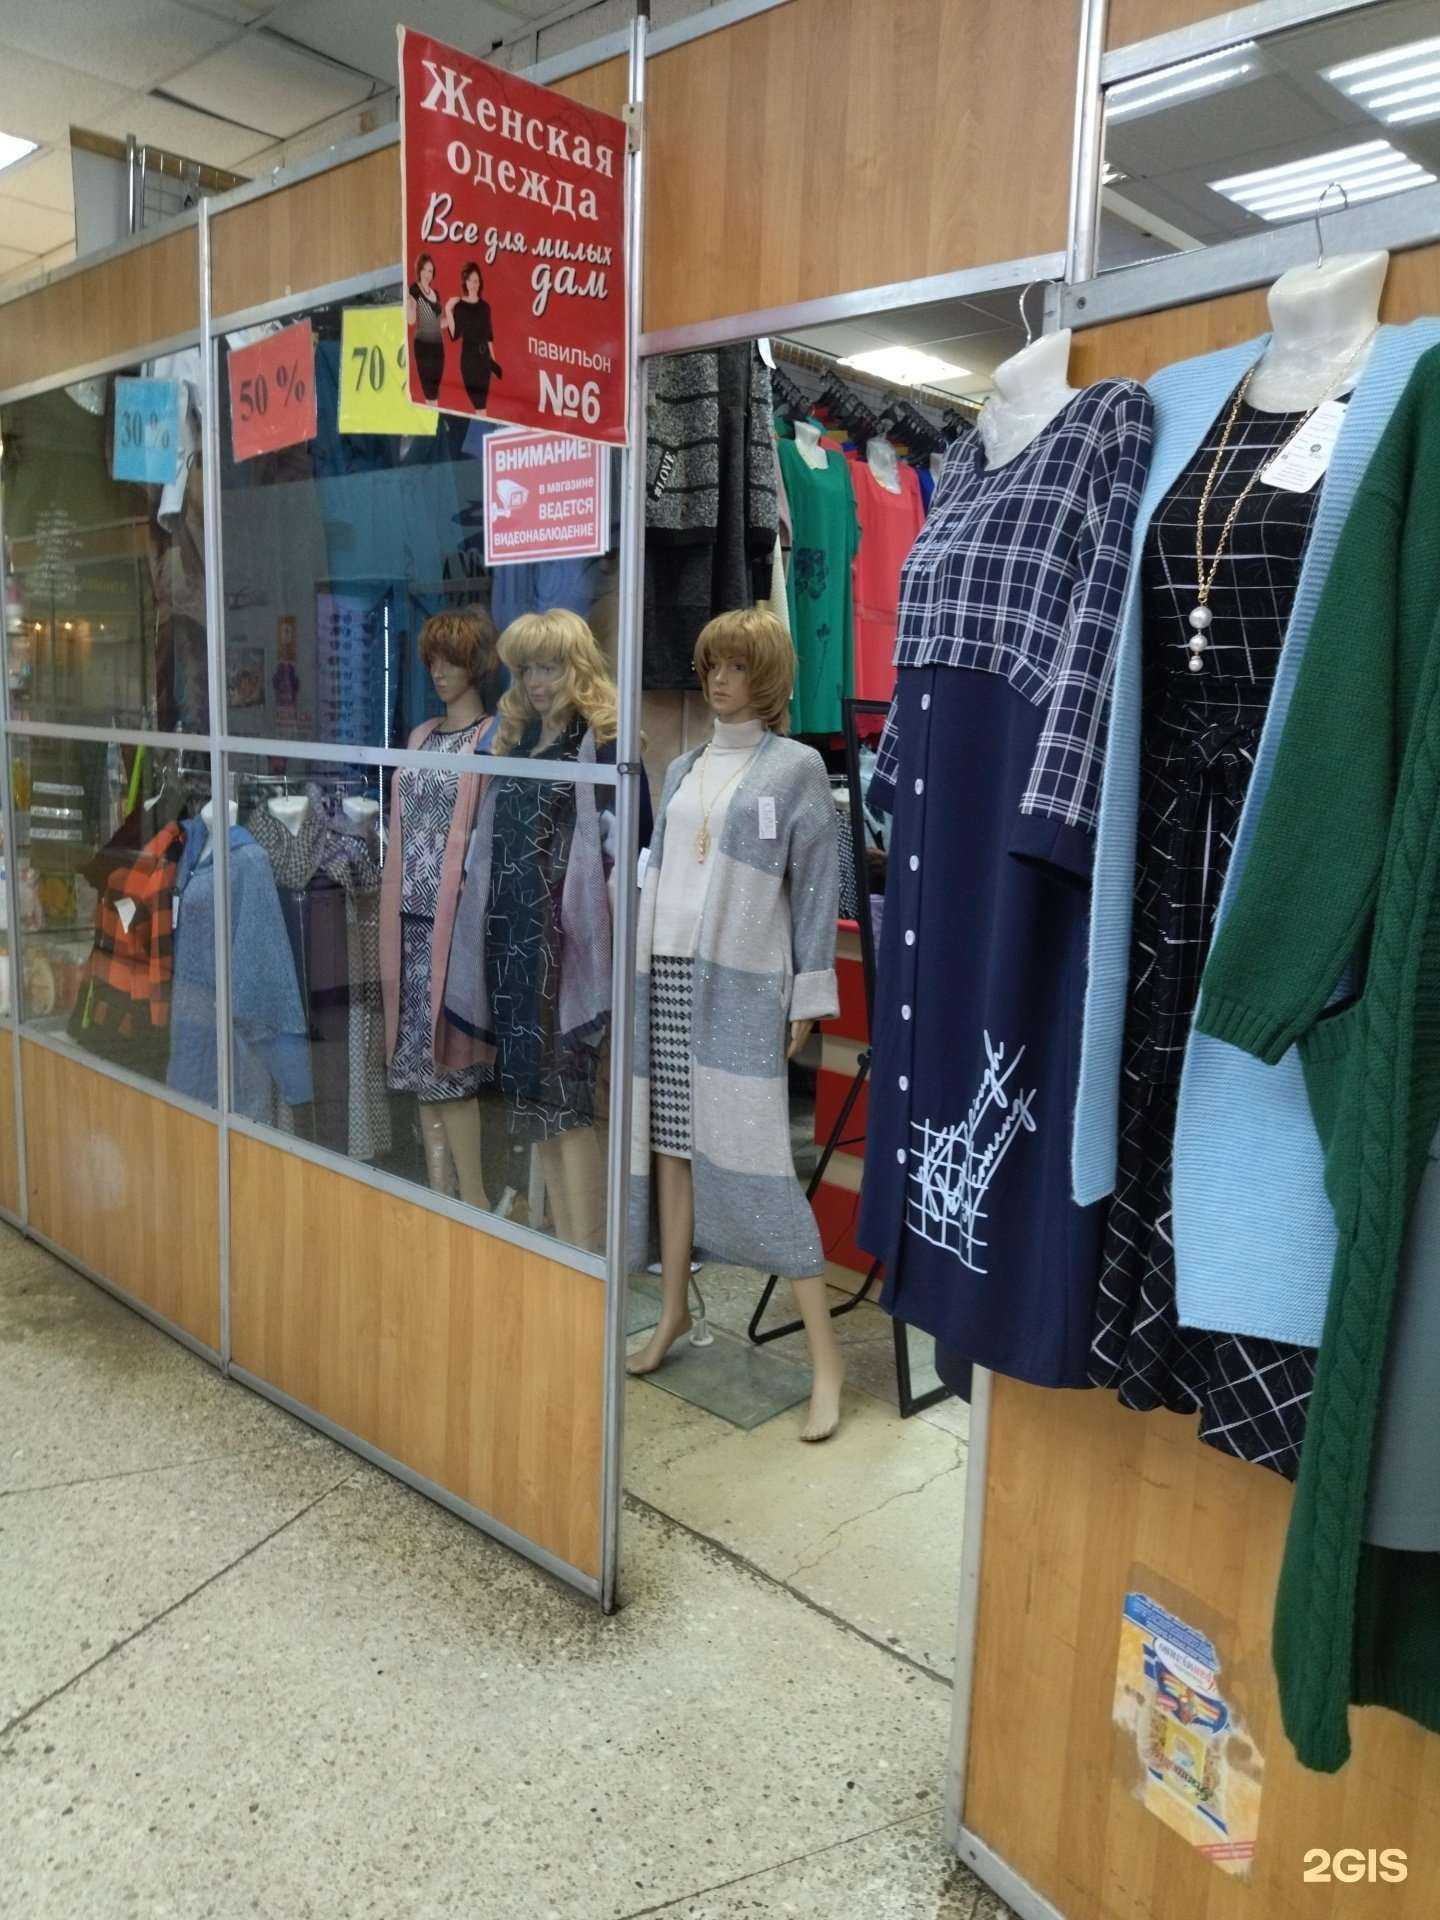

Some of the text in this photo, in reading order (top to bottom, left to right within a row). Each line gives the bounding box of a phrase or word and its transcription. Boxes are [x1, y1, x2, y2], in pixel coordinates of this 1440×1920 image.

[420, 59, 614, 178] Женская
[447, 140, 599, 222] одежда
[421, 191, 613, 266] Все для милых
[531, 263, 608, 316] дам
[528, 336, 612, 374] павильон
[537, 369, 601, 425] №6
[495, 439, 592, 472] ВНИМАНИЕ!
[547, 476, 594, 495] магазине
[538, 497, 594, 520] ВЕДЕТСЯ
[494, 522, 594, 547] ВИДЕОНАБЛЮДЕНИЕ
